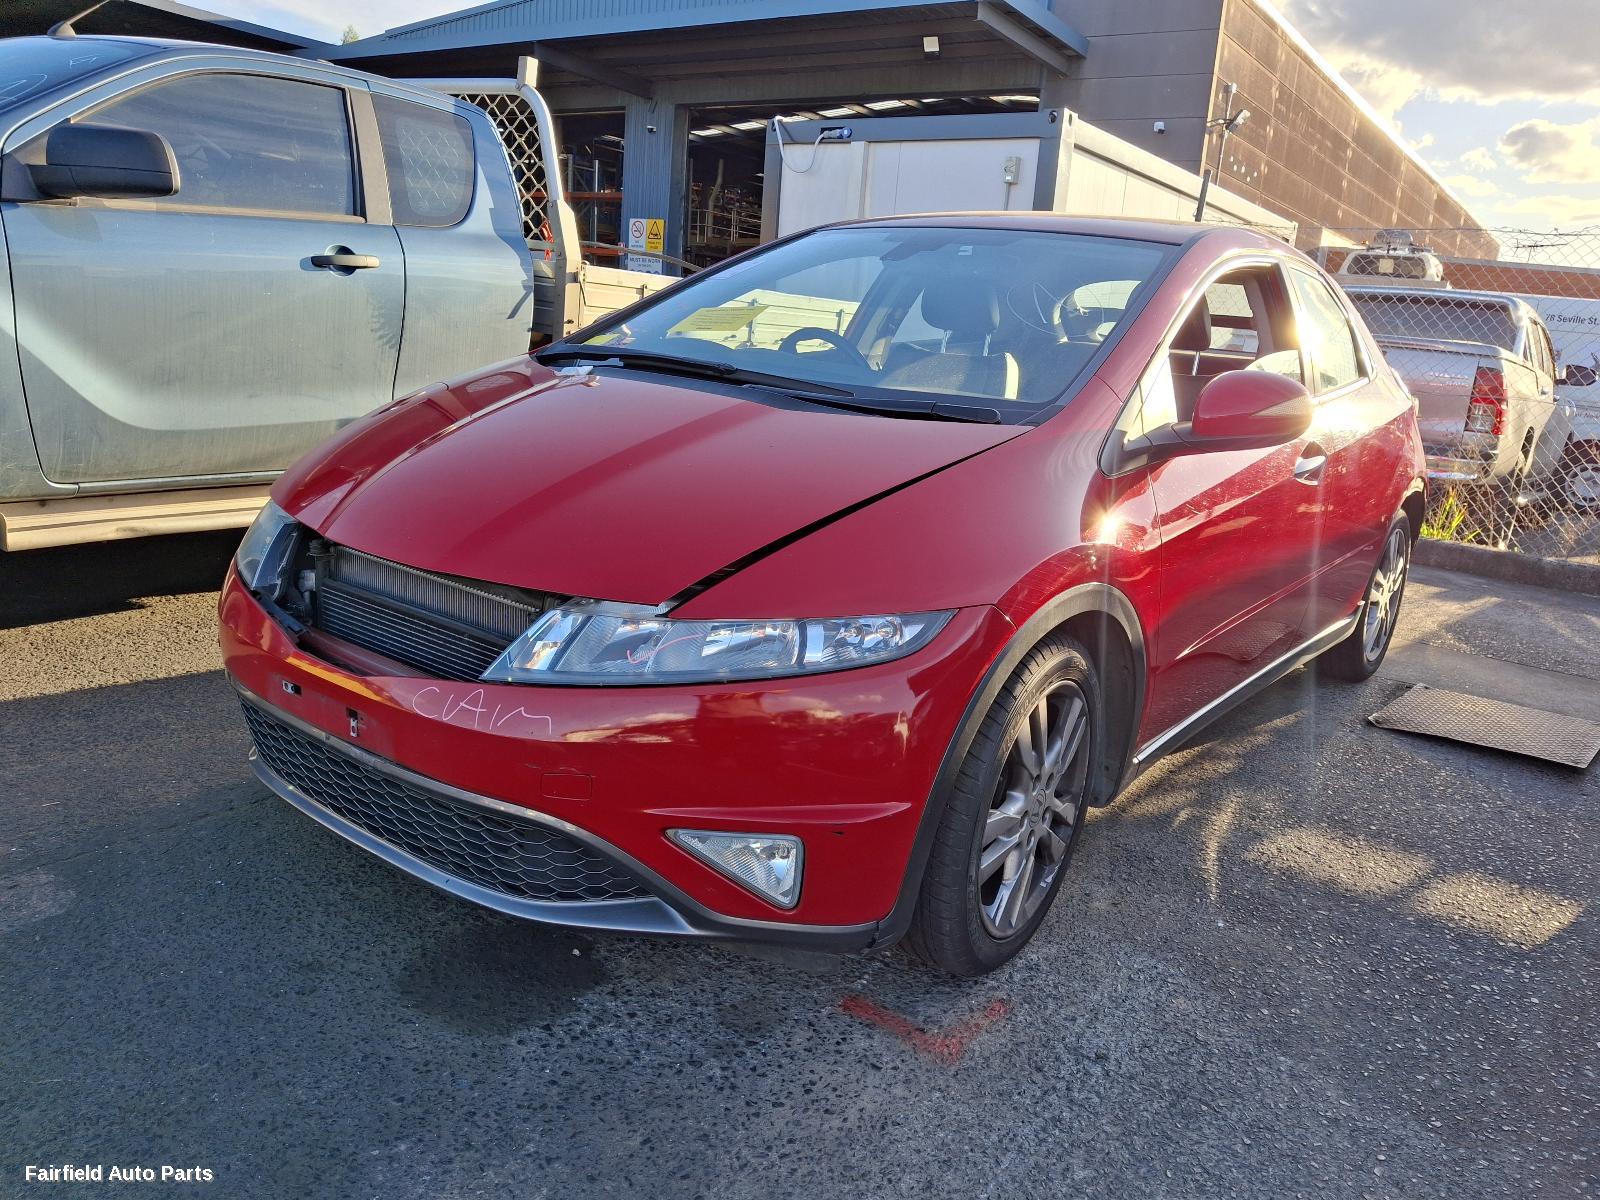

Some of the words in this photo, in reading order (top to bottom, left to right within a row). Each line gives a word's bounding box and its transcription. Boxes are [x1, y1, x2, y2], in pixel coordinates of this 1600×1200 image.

[1545, 313, 1555, 321] 78
[1557, 314, 1586, 324] Seville
[1588, 316, 1599, 325] St.
